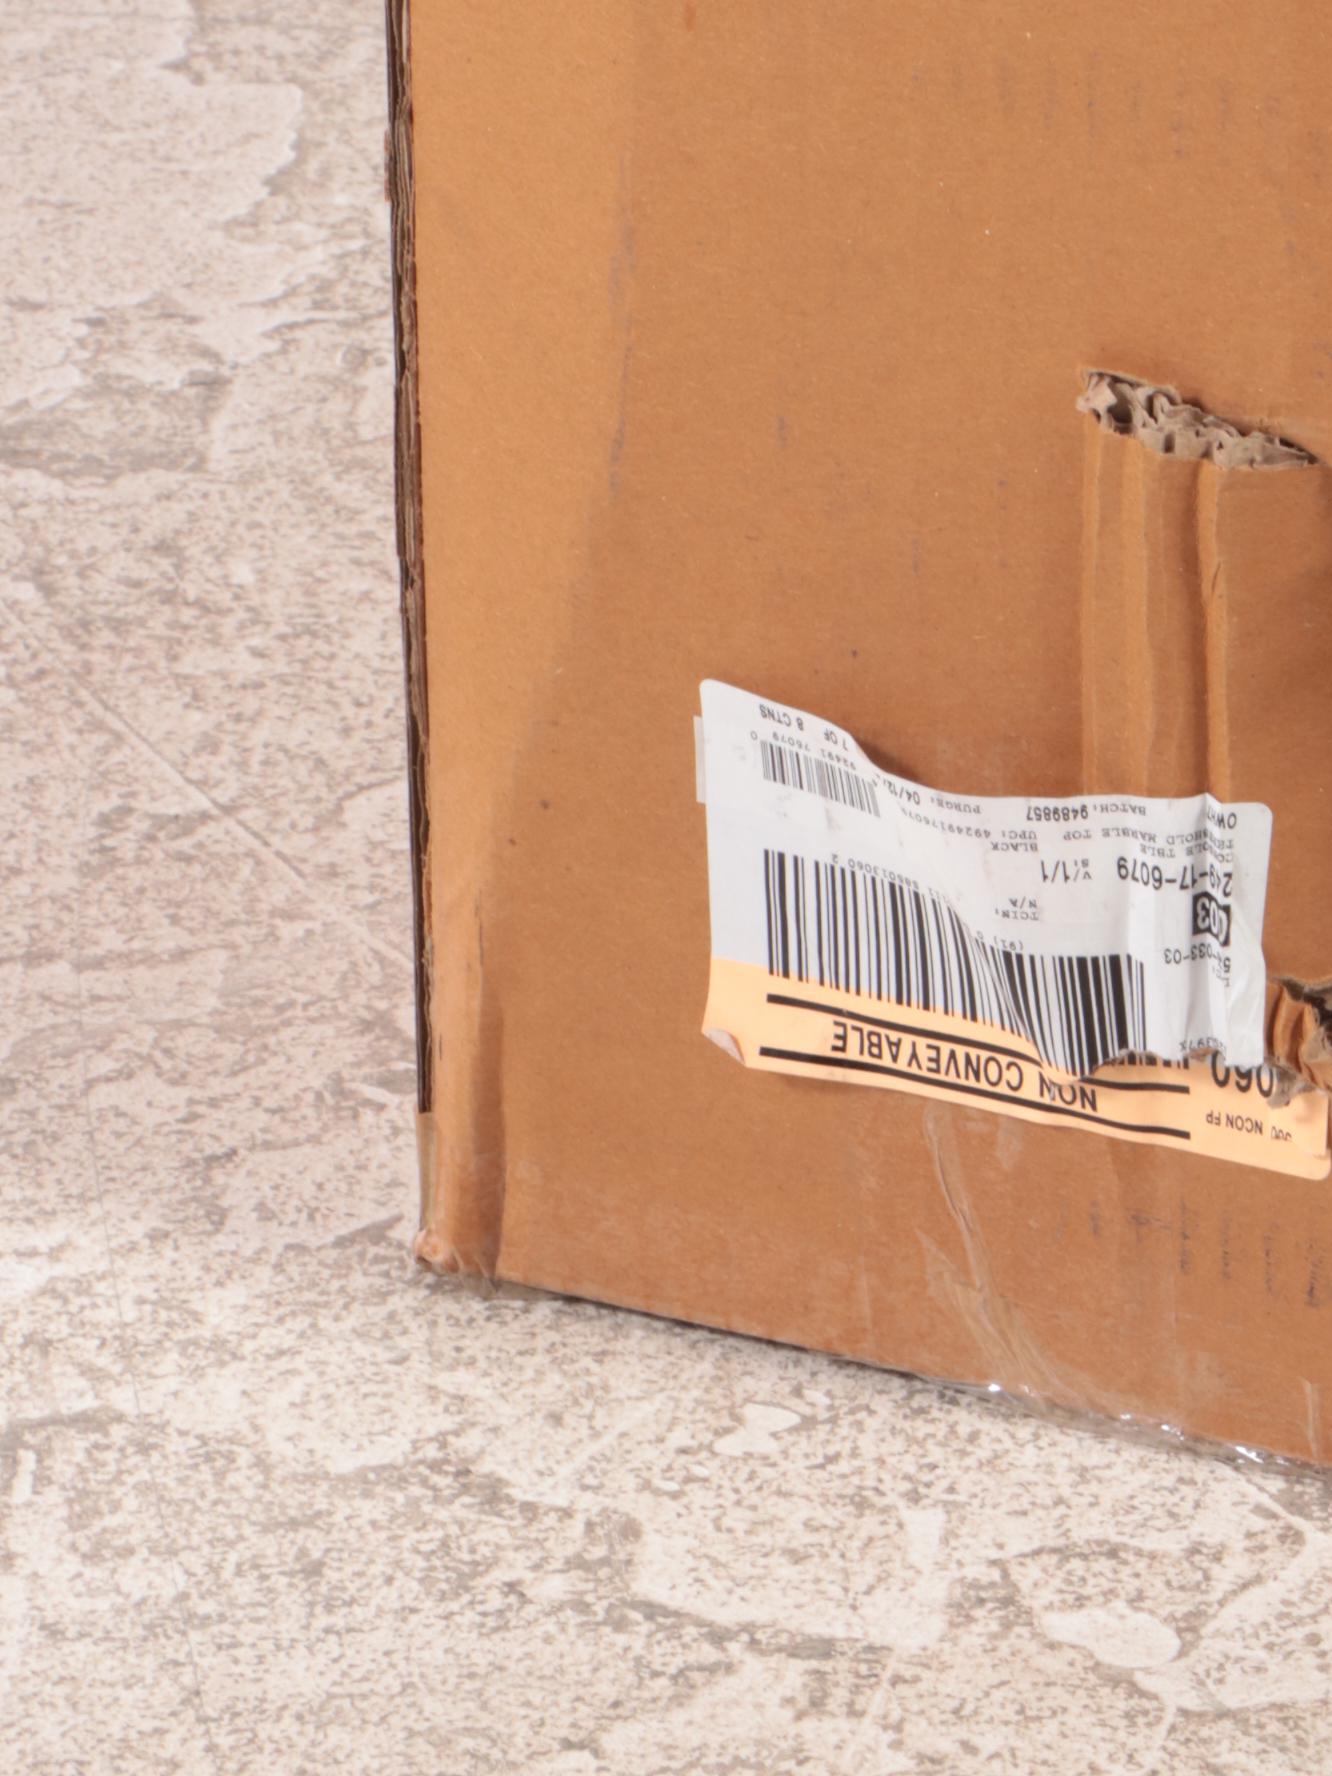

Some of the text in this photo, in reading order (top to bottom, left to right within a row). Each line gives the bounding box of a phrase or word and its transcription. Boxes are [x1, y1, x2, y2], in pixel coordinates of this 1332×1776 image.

[759, 704, 791, 727] CTNS
[772, 732, 810, 751] 76079
[823, 729, 838, 743] OF
[930, 797, 981, 814] PURGE:
[1026, 804, 1146, 821] BATCH: 9489857
[1001, 830, 1036, 839] UPC:
[1063, 830, 1091, 840] TOP
[1102, 828, 1156, 842] MARBLE
[990, 842, 1037, 851] BLACK
[1139, 844, 1175, 858] TBLE
[1040, 860, 1069, 883] 1/1
[1009, 897, 1037, 909] N/A
[995, 908, 1039, 920] TCIN:
[831, 1021, 1098, 1112] NON CONVEYABLE
[1206, 1110, 1221, 1126] FP
[1226, 1114, 1263, 1136] NCON
